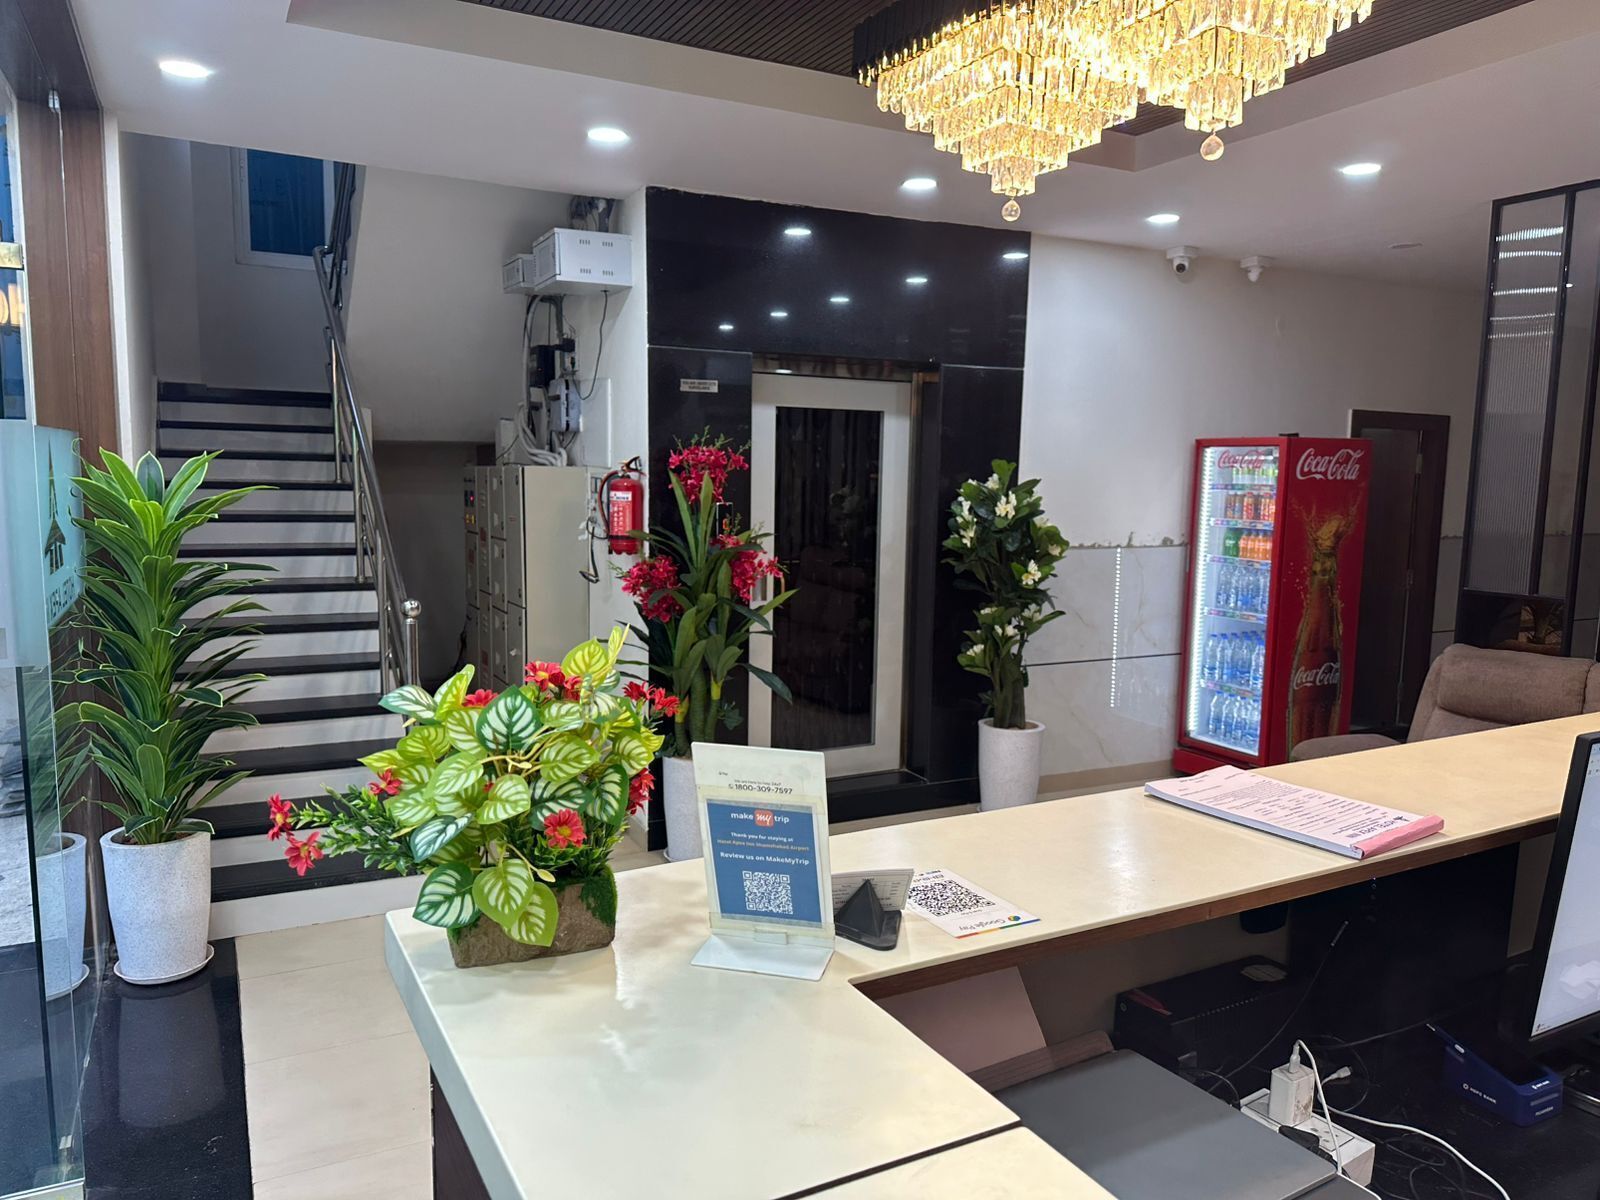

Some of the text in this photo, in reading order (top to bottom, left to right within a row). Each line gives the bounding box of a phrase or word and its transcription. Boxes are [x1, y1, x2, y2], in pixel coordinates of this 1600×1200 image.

[1218, 449, 1265, 469] Coca-Cola
[1296, 448, 1364, 480] Coca-Cola
[1293, 662, 1340, 690] Coca-Cola
[734, 784, 793, 794] 1800-309-7597
[731, 812, 790, 826] make my trip
[766, 856, 810, 865] MakeMyTrip
